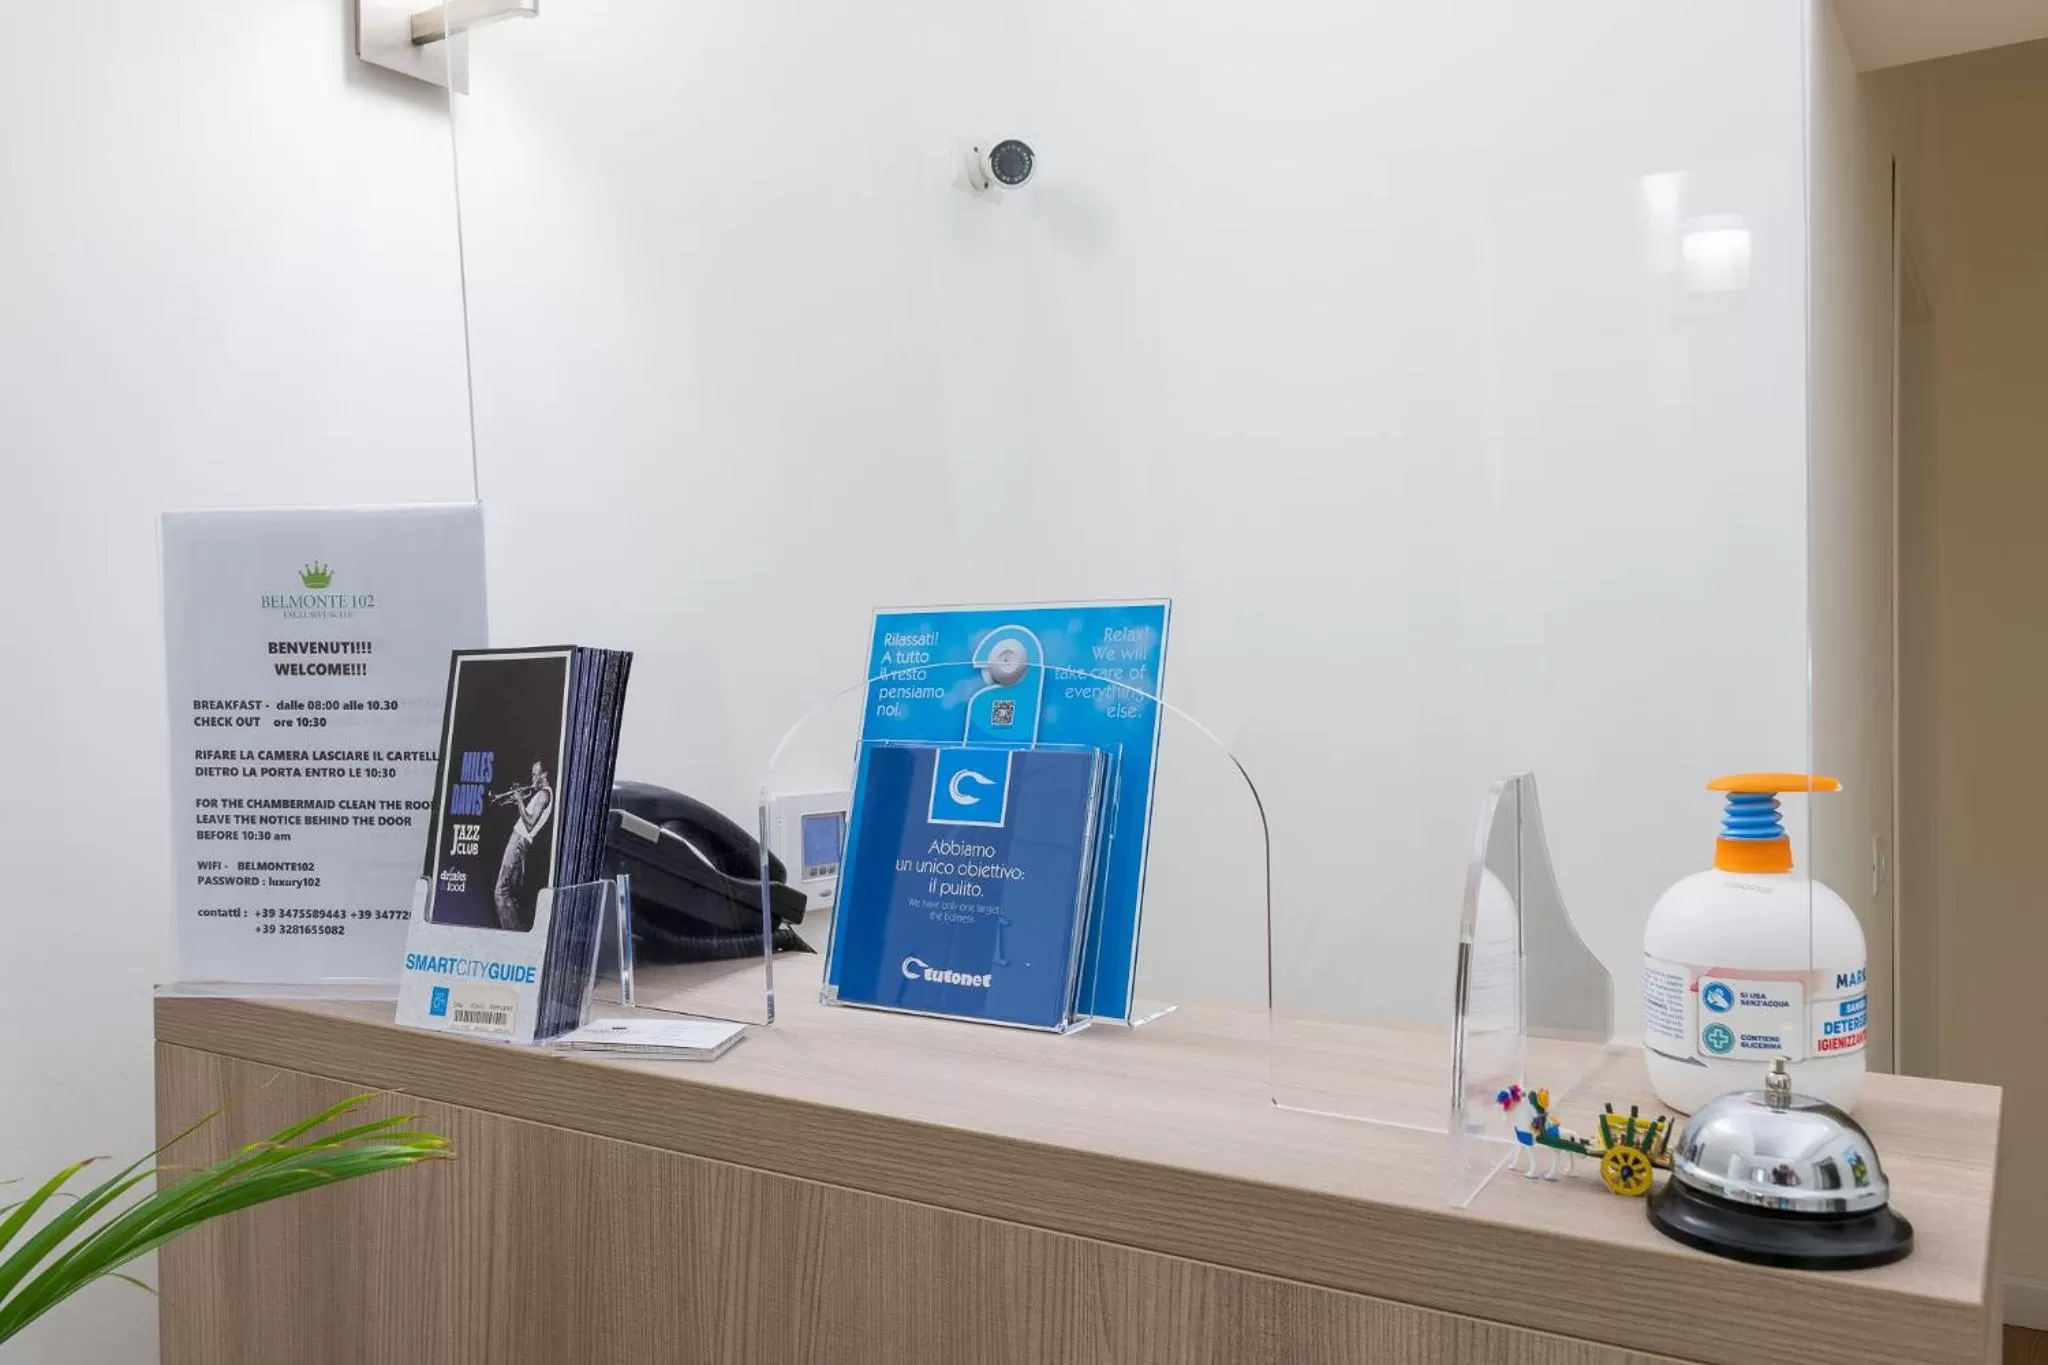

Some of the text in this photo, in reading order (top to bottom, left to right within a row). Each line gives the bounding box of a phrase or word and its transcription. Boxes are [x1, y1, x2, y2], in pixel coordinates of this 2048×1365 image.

[261, 594, 376, 609] BELMONTE 102
[884, 631, 939, 647] Rilassati!
[1103, 626, 1149, 641] Relax!
[268, 641, 372, 654] BENVENUTI!!!
[1091, 645, 1146, 661] We will
[881, 650, 930, 664] A tutto
[274, 663, 367, 676] WELCOME!!!
[890, 668, 927, 681] resto
[1091, 667, 1123, 680] care
[1129, 664, 1147, 680] of
[878, 684, 944, 701] pensiamo
[1064, 683, 1144, 703] everything
[193, 699, 262, 710] BREAKFAST
[276, 700, 305, 710] dalle
[307, 700, 340, 710] 08:00
[343, 700, 364, 710] alle
[367, 700, 398, 710] 10.30
[876, 702, 901, 716] noi.
[1106, 703, 1141, 718] else.
[194, 716, 327, 727] CHECK OUT ore 10:30
[195, 750, 237, 760] RIFARE
[240, 750, 255, 760] LA
[258, 750, 309, 761] CAMERA
[312, 750, 370, 761] LASCIARE
[373, 751, 383, 761] IL
[195, 766, 396, 778] DIETRO LA PORTA ENTRO LE 10:30
[460, 751, 494, 783] MILES
[196, 798, 218, 808] FOR
[221, 798, 244, 808] THE
[246, 799, 336, 809] CHAMBERMAID
[338, 800, 376, 810] CLEAN
[379, 800, 402, 810] THE
[451, 783, 485, 816] DAVIS
[196, 814, 412, 826] LEAVE THE NOTICE BEHIND THE DOOR
[196, 830, 291, 841] BEFORE 10:30 am
[450, 823, 481, 856] JAZZ
[456, 843, 479, 855] CLUB
[928, 839, 996, 858] Abbiamo
[197, 861, 222, 870] WIFI
[237, 861, 315, 872] BELMONTE102
[895, 858, 1025, 880] un unico obiettivo:
[197, 876, 260, 886] PASSWORD
[268, 877, 321, 889] luxury102
[447, 881, 465, 892] food
[929, 877, 984, 897] il pulito.
[197, 908, 241, 917] contatti
[255, 908, 276, 918] +39
[278, 908, 346, 919] 3475589443
[350, 910, 372, 920] +39
[255, 924, 345, 935] +39 3281655082
[1740, 1000, 1789, 1008] SENZ'ACQUA
